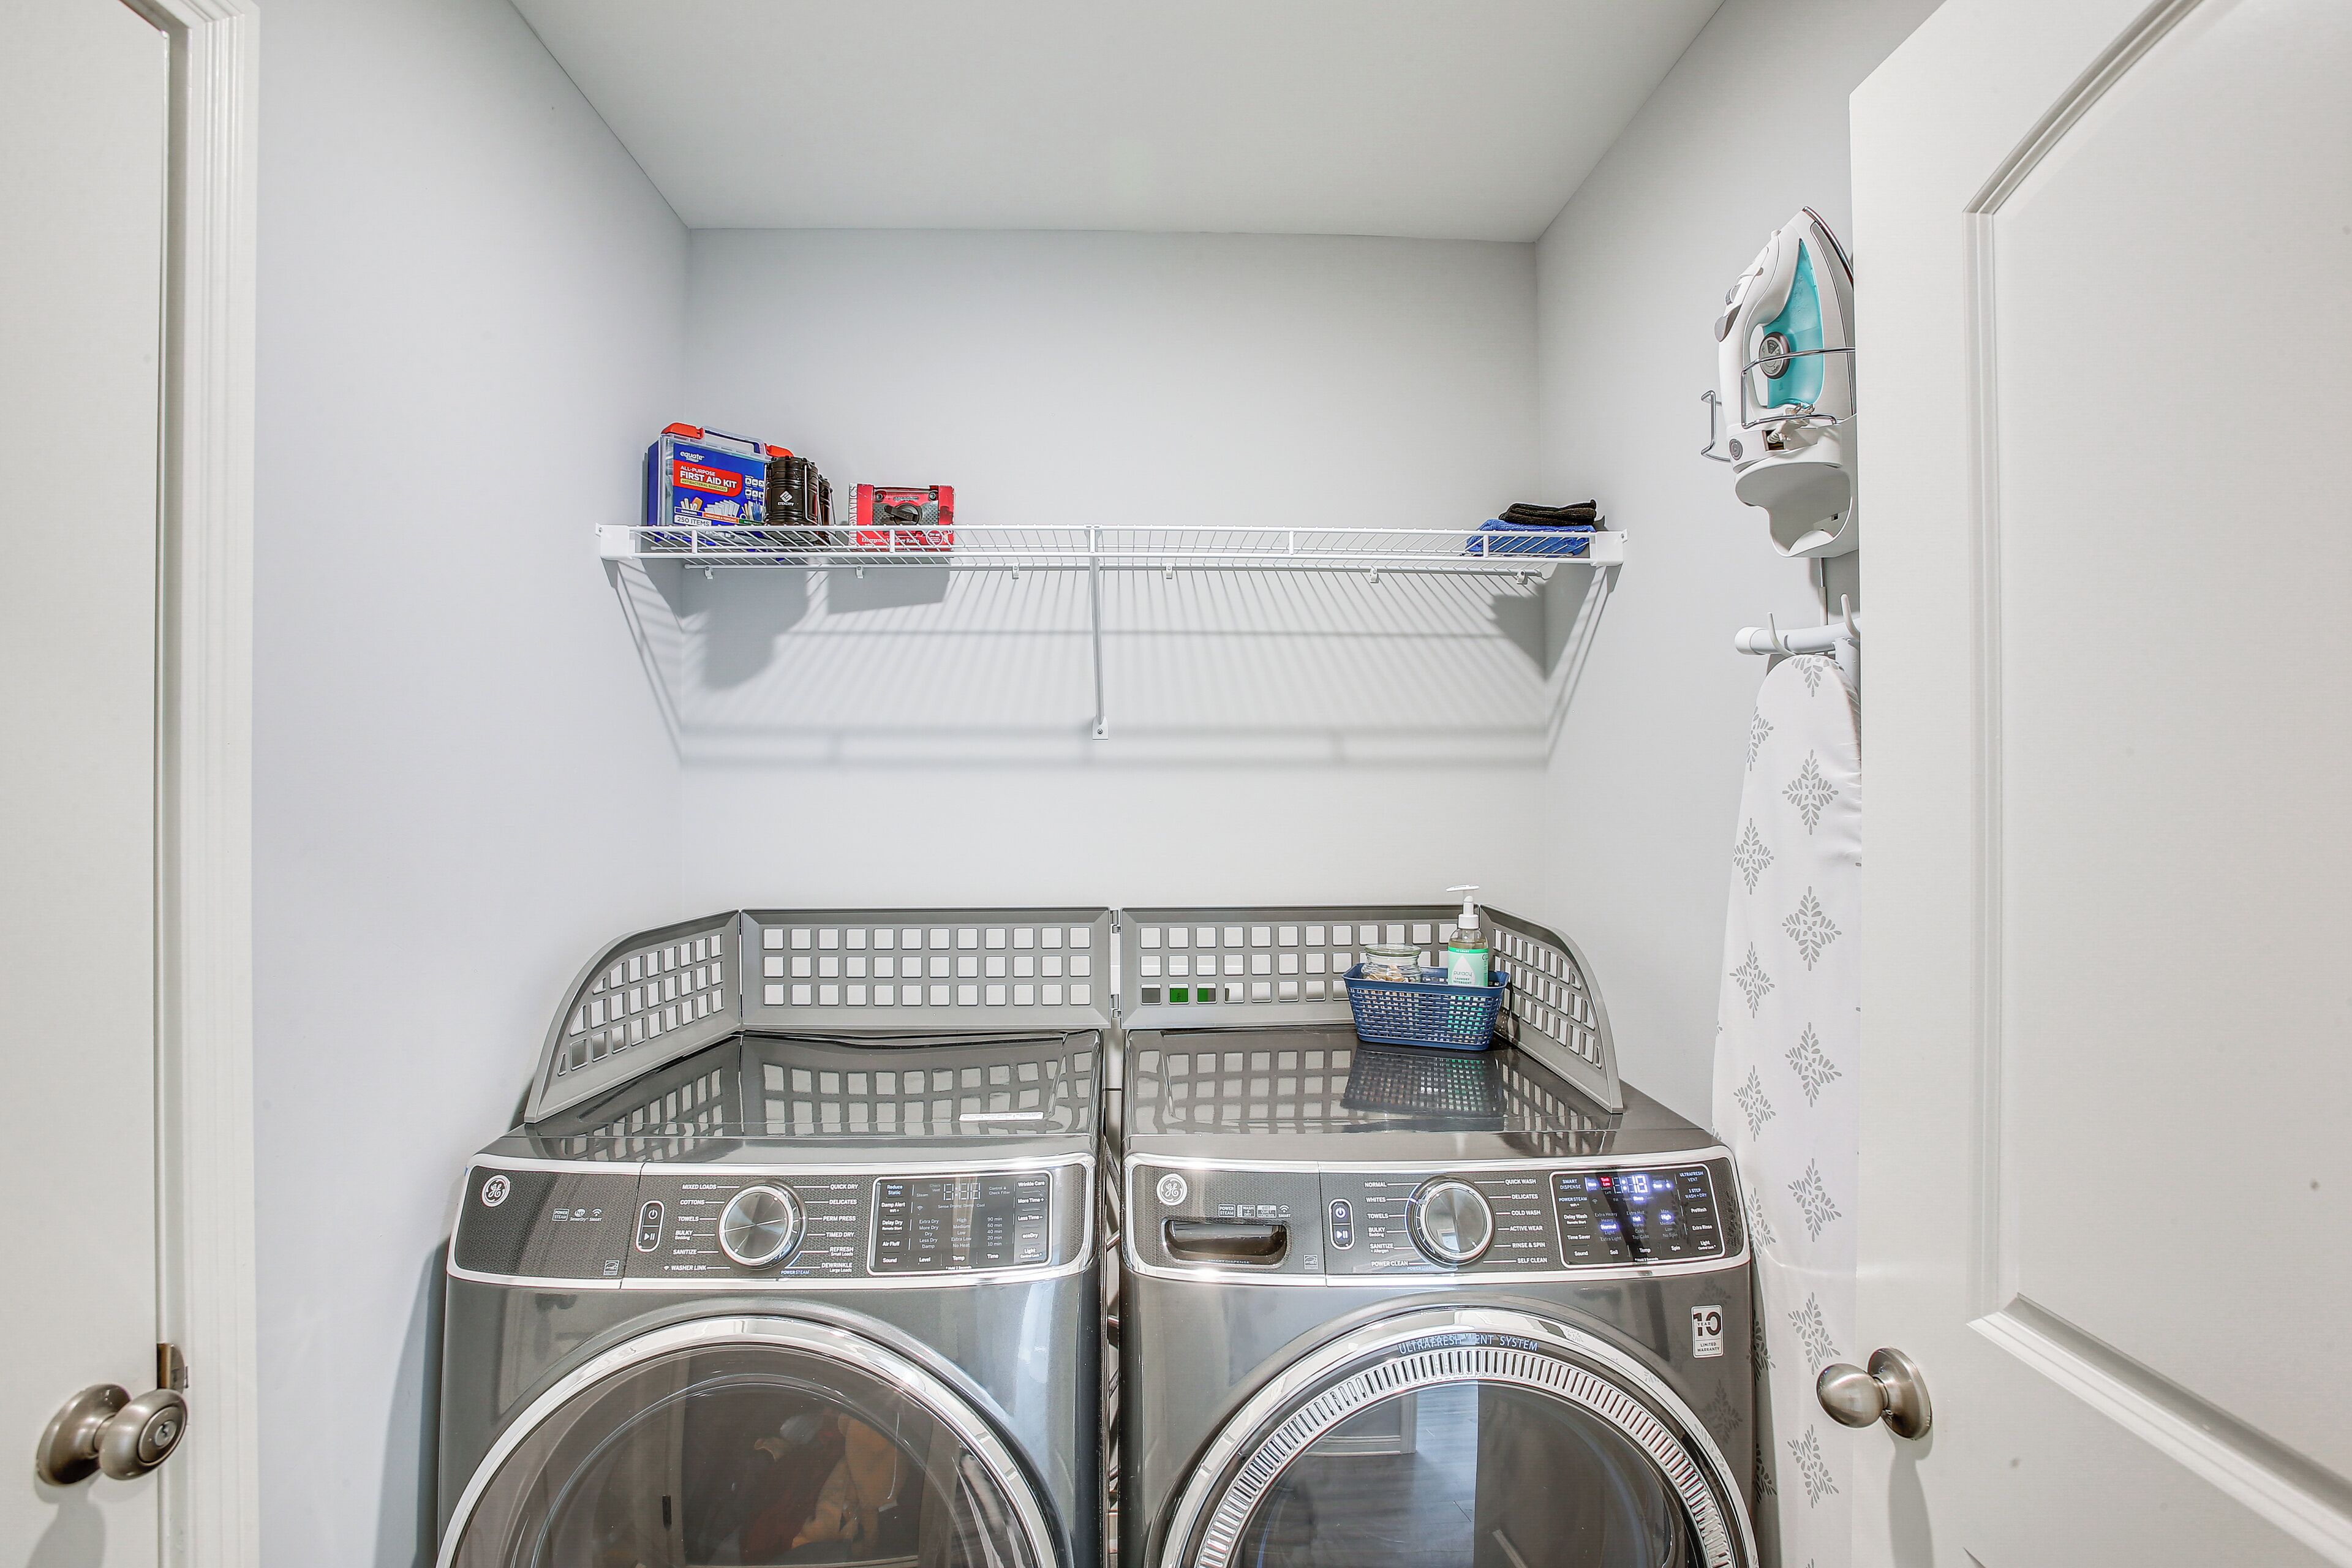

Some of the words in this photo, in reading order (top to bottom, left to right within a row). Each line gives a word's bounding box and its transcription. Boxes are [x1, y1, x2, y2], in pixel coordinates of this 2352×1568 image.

[680, 451, 703, 461] equate
[680, 466, 715, 477] ALL-PURPOSE
[680, 470, 704, 482] FIRST
[723, 479, 737, 488] KIT
[682, 480, 708, 488] ANTIBACTERIAL
[1693, 1311, 1721, 1336] 10
[1397, 1335, 1463, 1354] ULTRAFRESH
[1499, 1336, 1539, 1351] SYSTEM
